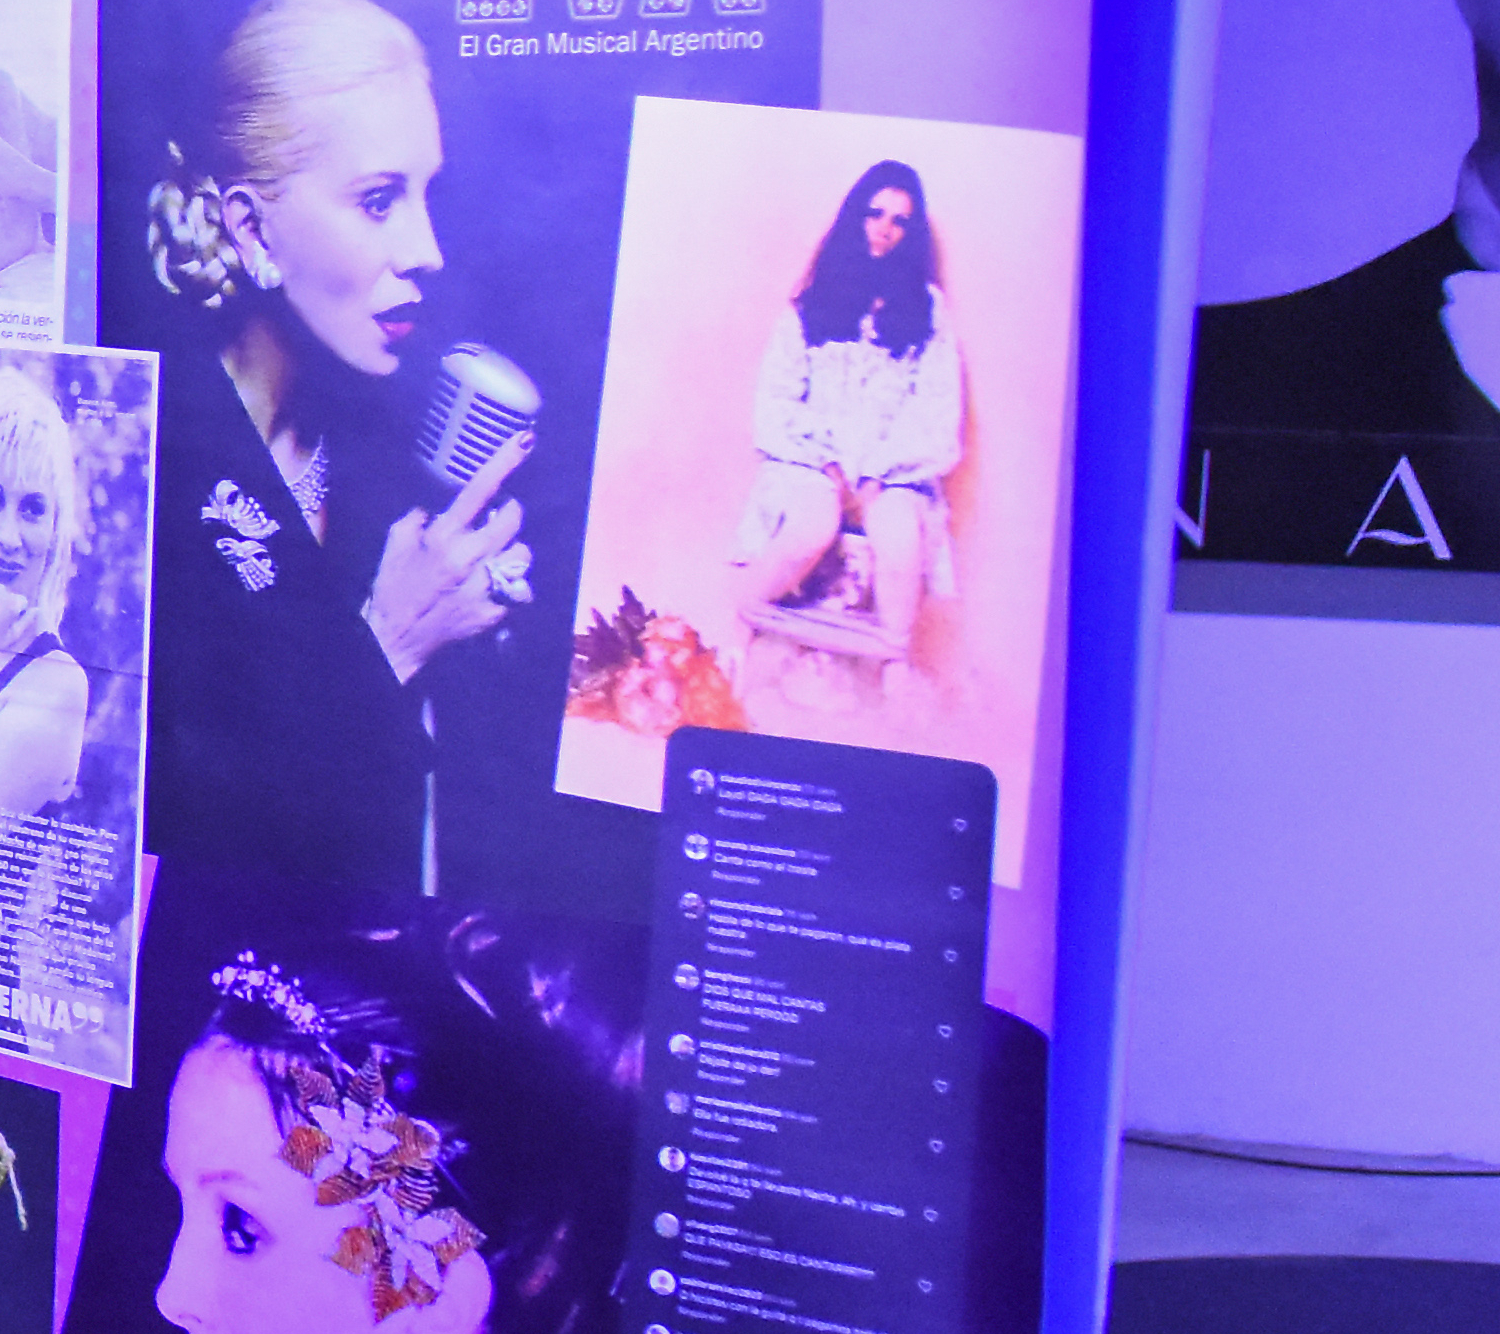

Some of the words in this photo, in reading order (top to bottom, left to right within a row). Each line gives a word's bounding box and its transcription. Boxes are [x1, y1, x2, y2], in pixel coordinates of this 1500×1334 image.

[459, 35, 479, 57] El
[485, 33, 540, 57] Gran
[547, 29, 637, 55] Musical
[644, 26, 765, 57] Argentino
